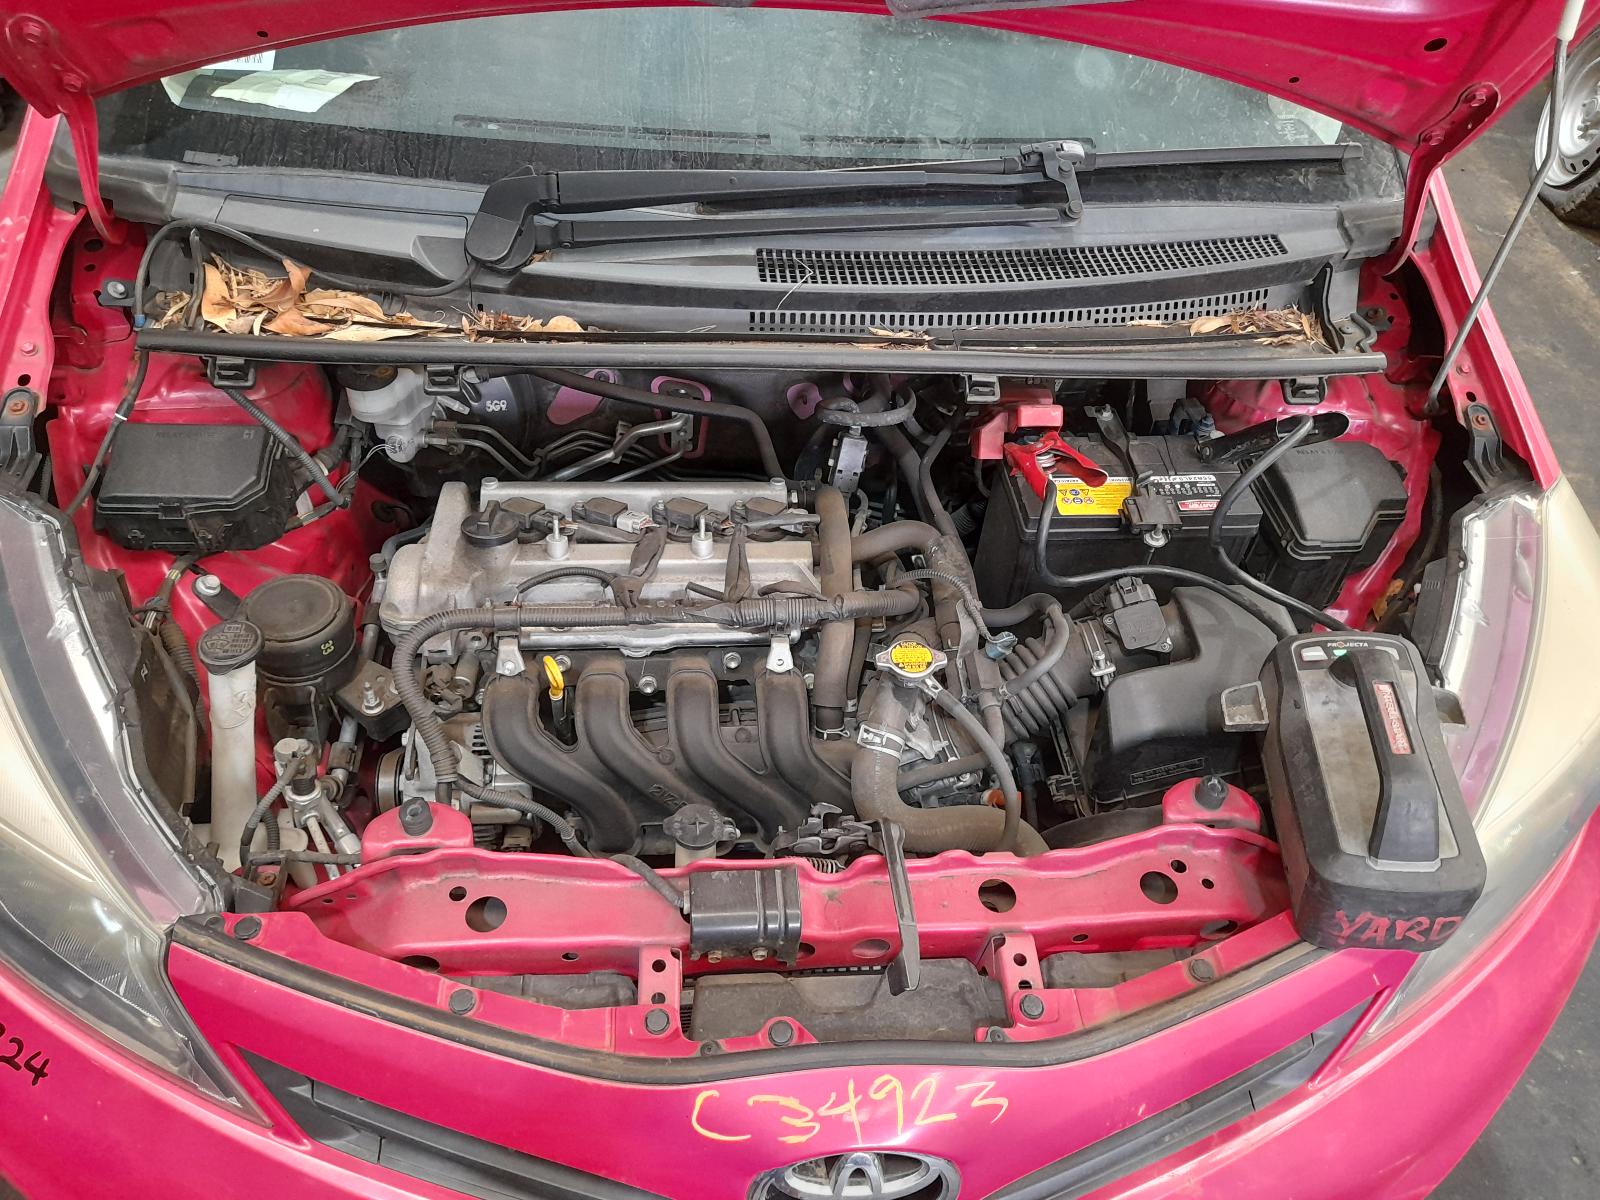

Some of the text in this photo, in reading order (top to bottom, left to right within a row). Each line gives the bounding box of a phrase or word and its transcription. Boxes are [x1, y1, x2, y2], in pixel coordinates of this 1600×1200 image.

[320, 639, 335, 656] 33
[1327, 641, 1368, 649] PROJECTA
[1328, 910, 1463, 945] YARD
[0, 1022, 50, 1086] 24
